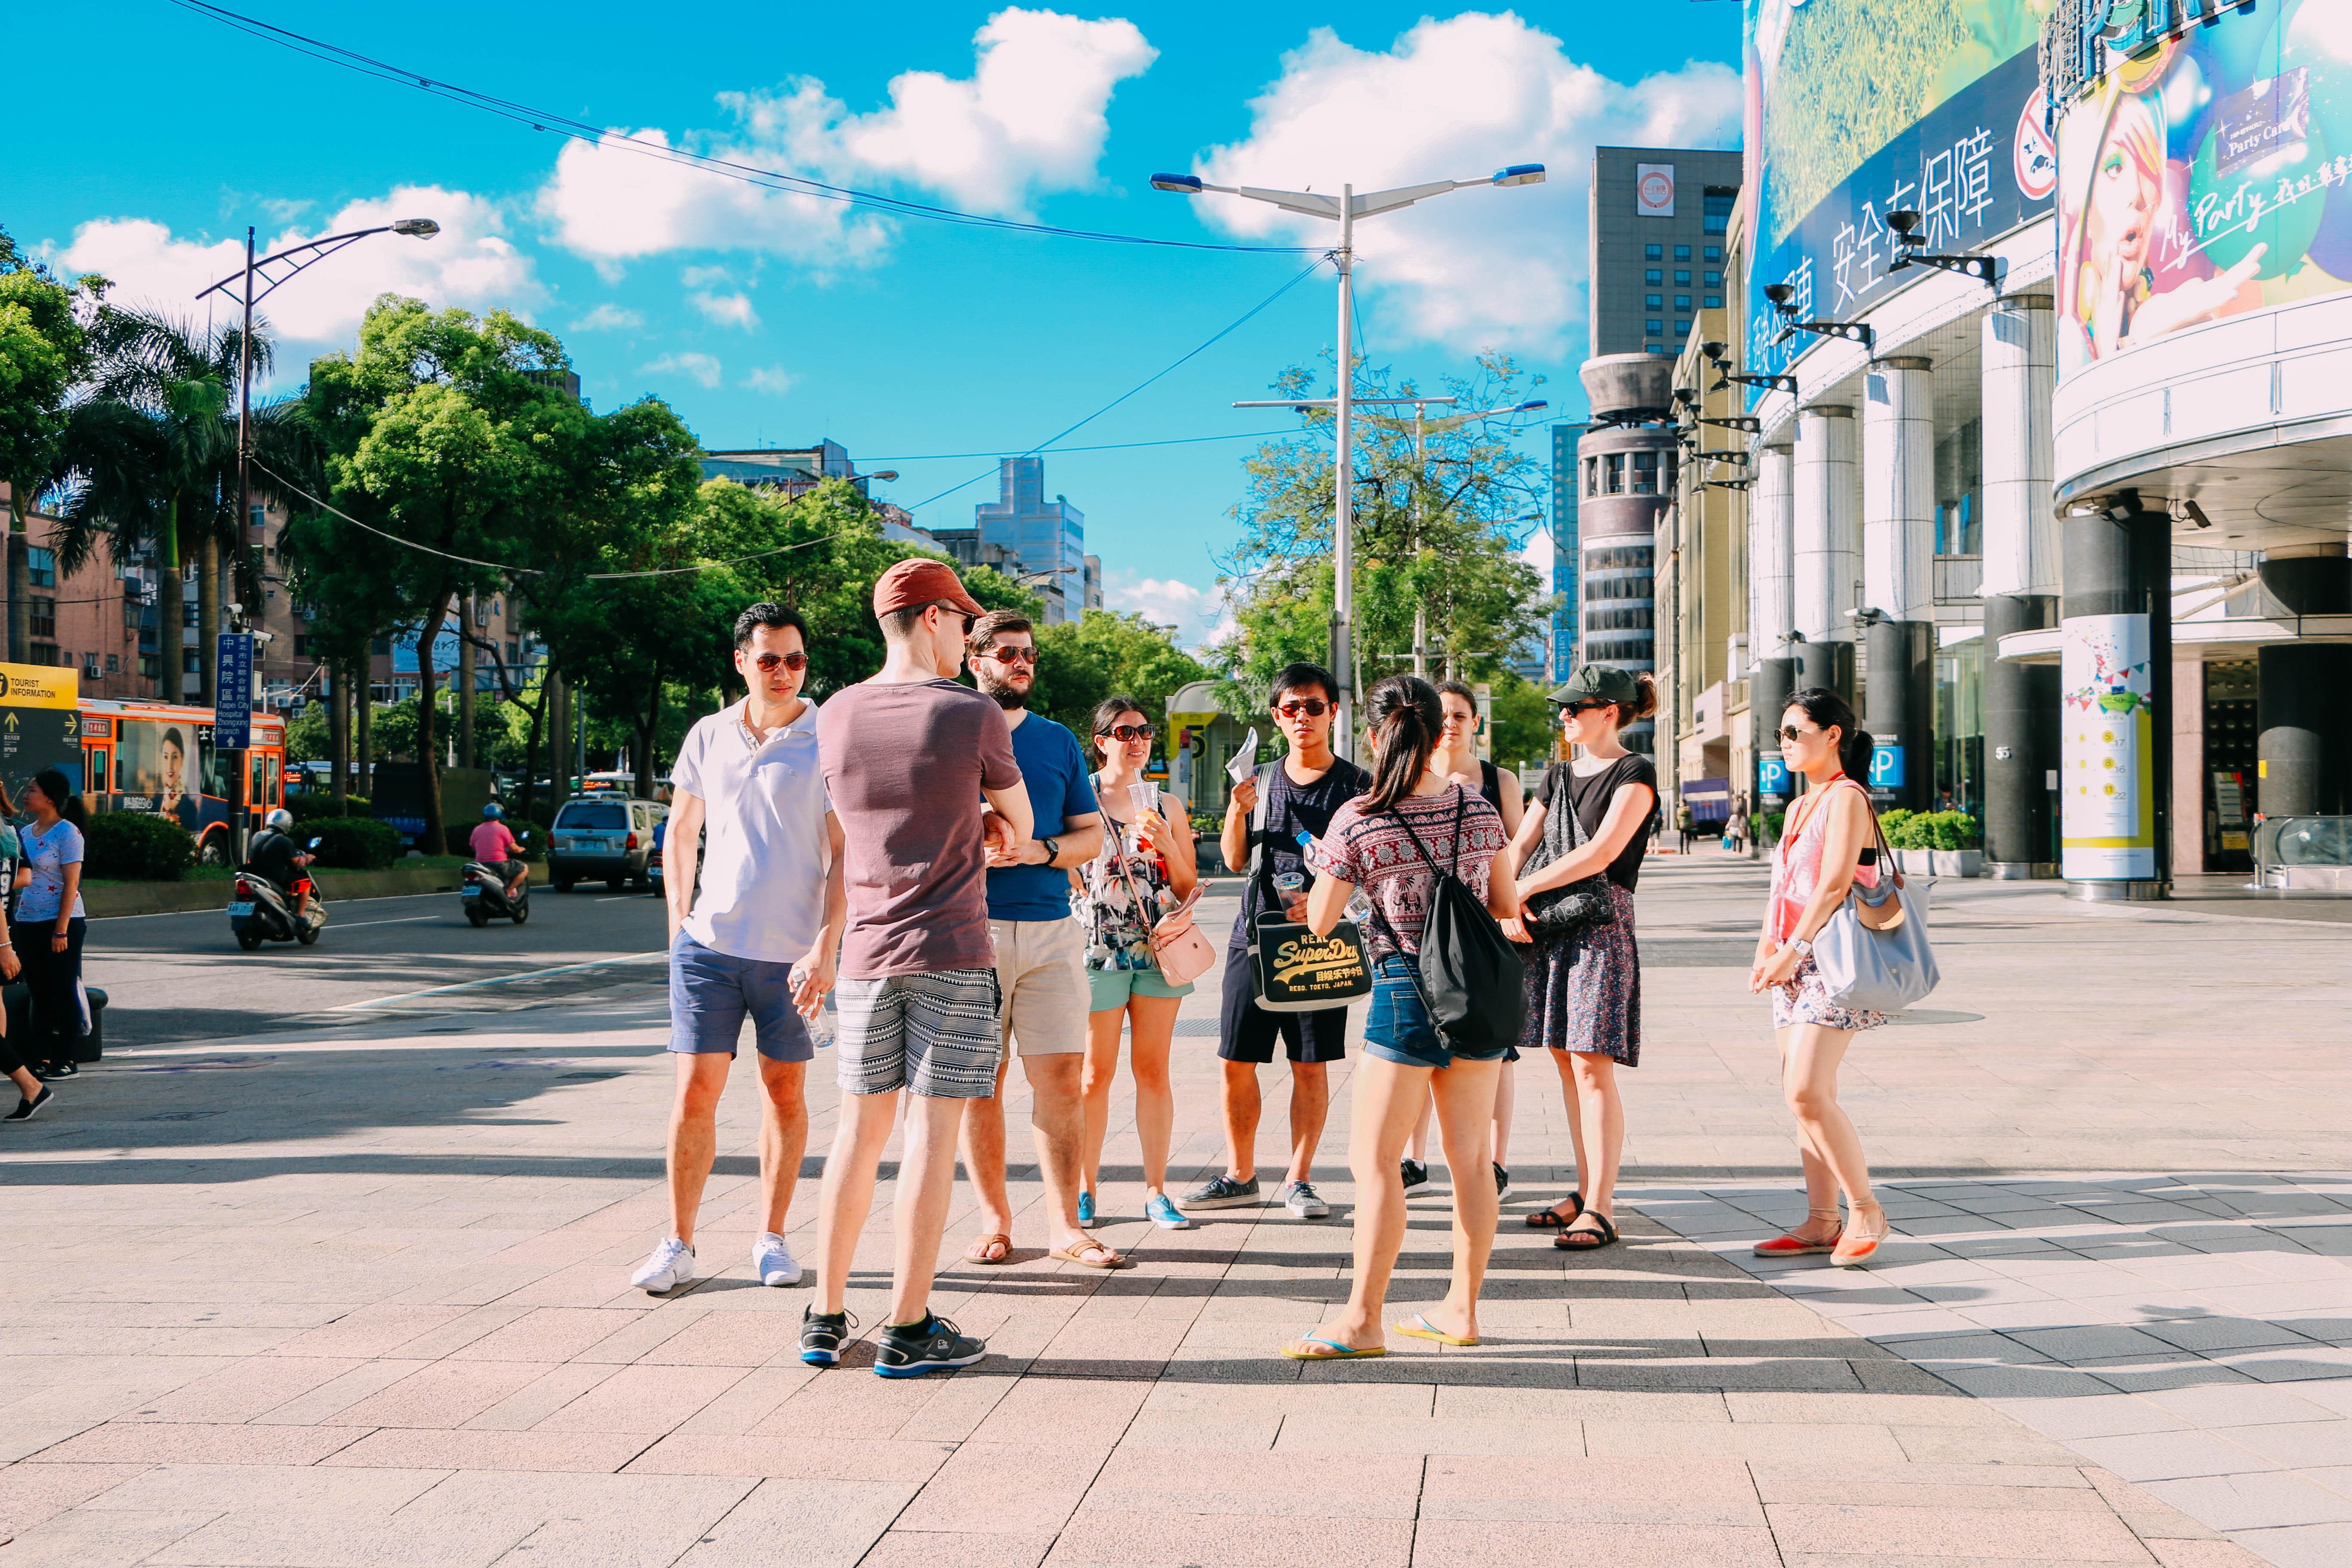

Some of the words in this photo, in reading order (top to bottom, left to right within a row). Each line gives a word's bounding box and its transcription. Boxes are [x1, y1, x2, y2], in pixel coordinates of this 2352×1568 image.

[2230, 134, 2261, 157] Party
[2159, 214, 2194, 270] My
[221, 637, 234, 701] 中興院區
[11, 678, 39, 688] TOURIST
[11, 689, 56, 698] INFORMATION
[218, 701, 236, 710] Taipei
[238, 701, 249, 710] City
[218, 710, 243, 719] Hospital
[217, 718, 248, 727] Zhongxing
[2104, 732, 2110, 741] 5
[1876, 750, 1894, 782] P
[1767, 763, 1781, 789] P
[1301, 934, 1329, 944] REAL
